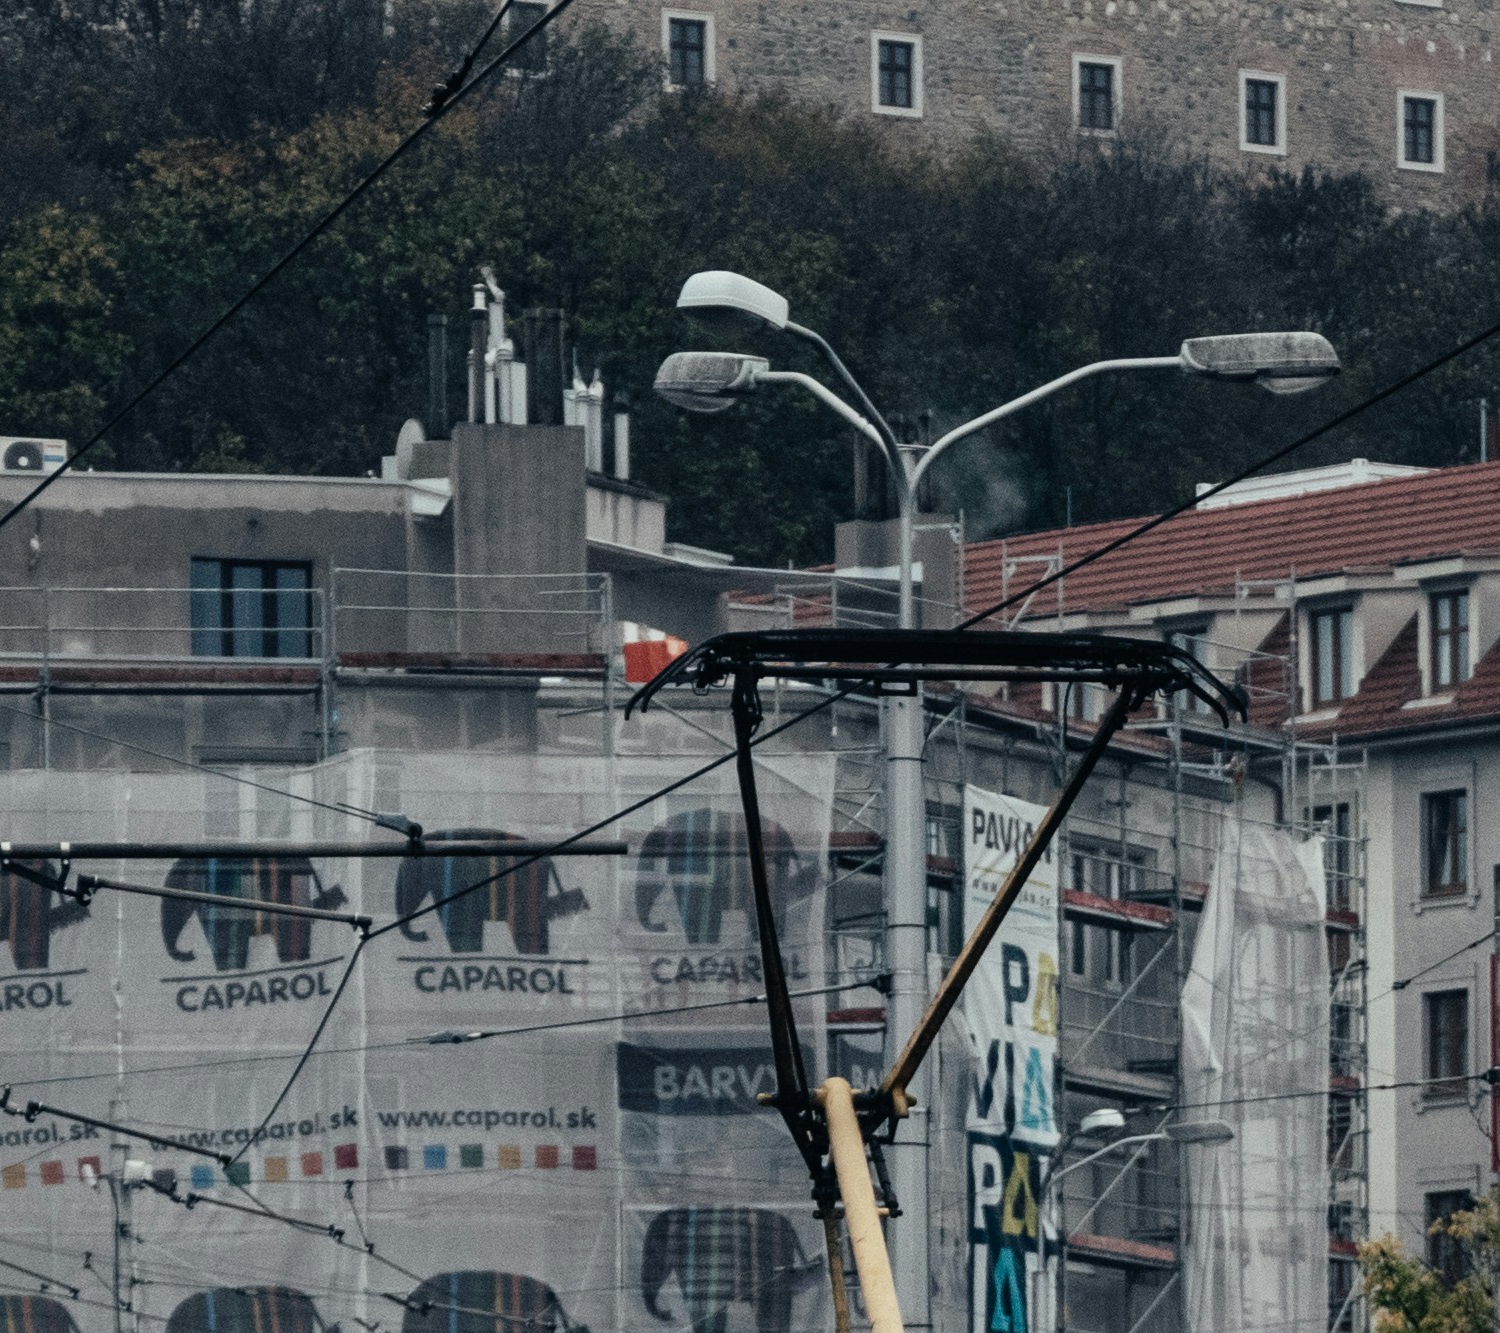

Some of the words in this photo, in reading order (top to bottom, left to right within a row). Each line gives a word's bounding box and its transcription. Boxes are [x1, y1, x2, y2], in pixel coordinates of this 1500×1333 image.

[414, 965, 575, 995] CAPAROL
[651, 954, 808, 986] CAPARL
[176, 969, 332, 1012] CAPAROL
[378, 1106, 597, 1131] www.caparol.sk
